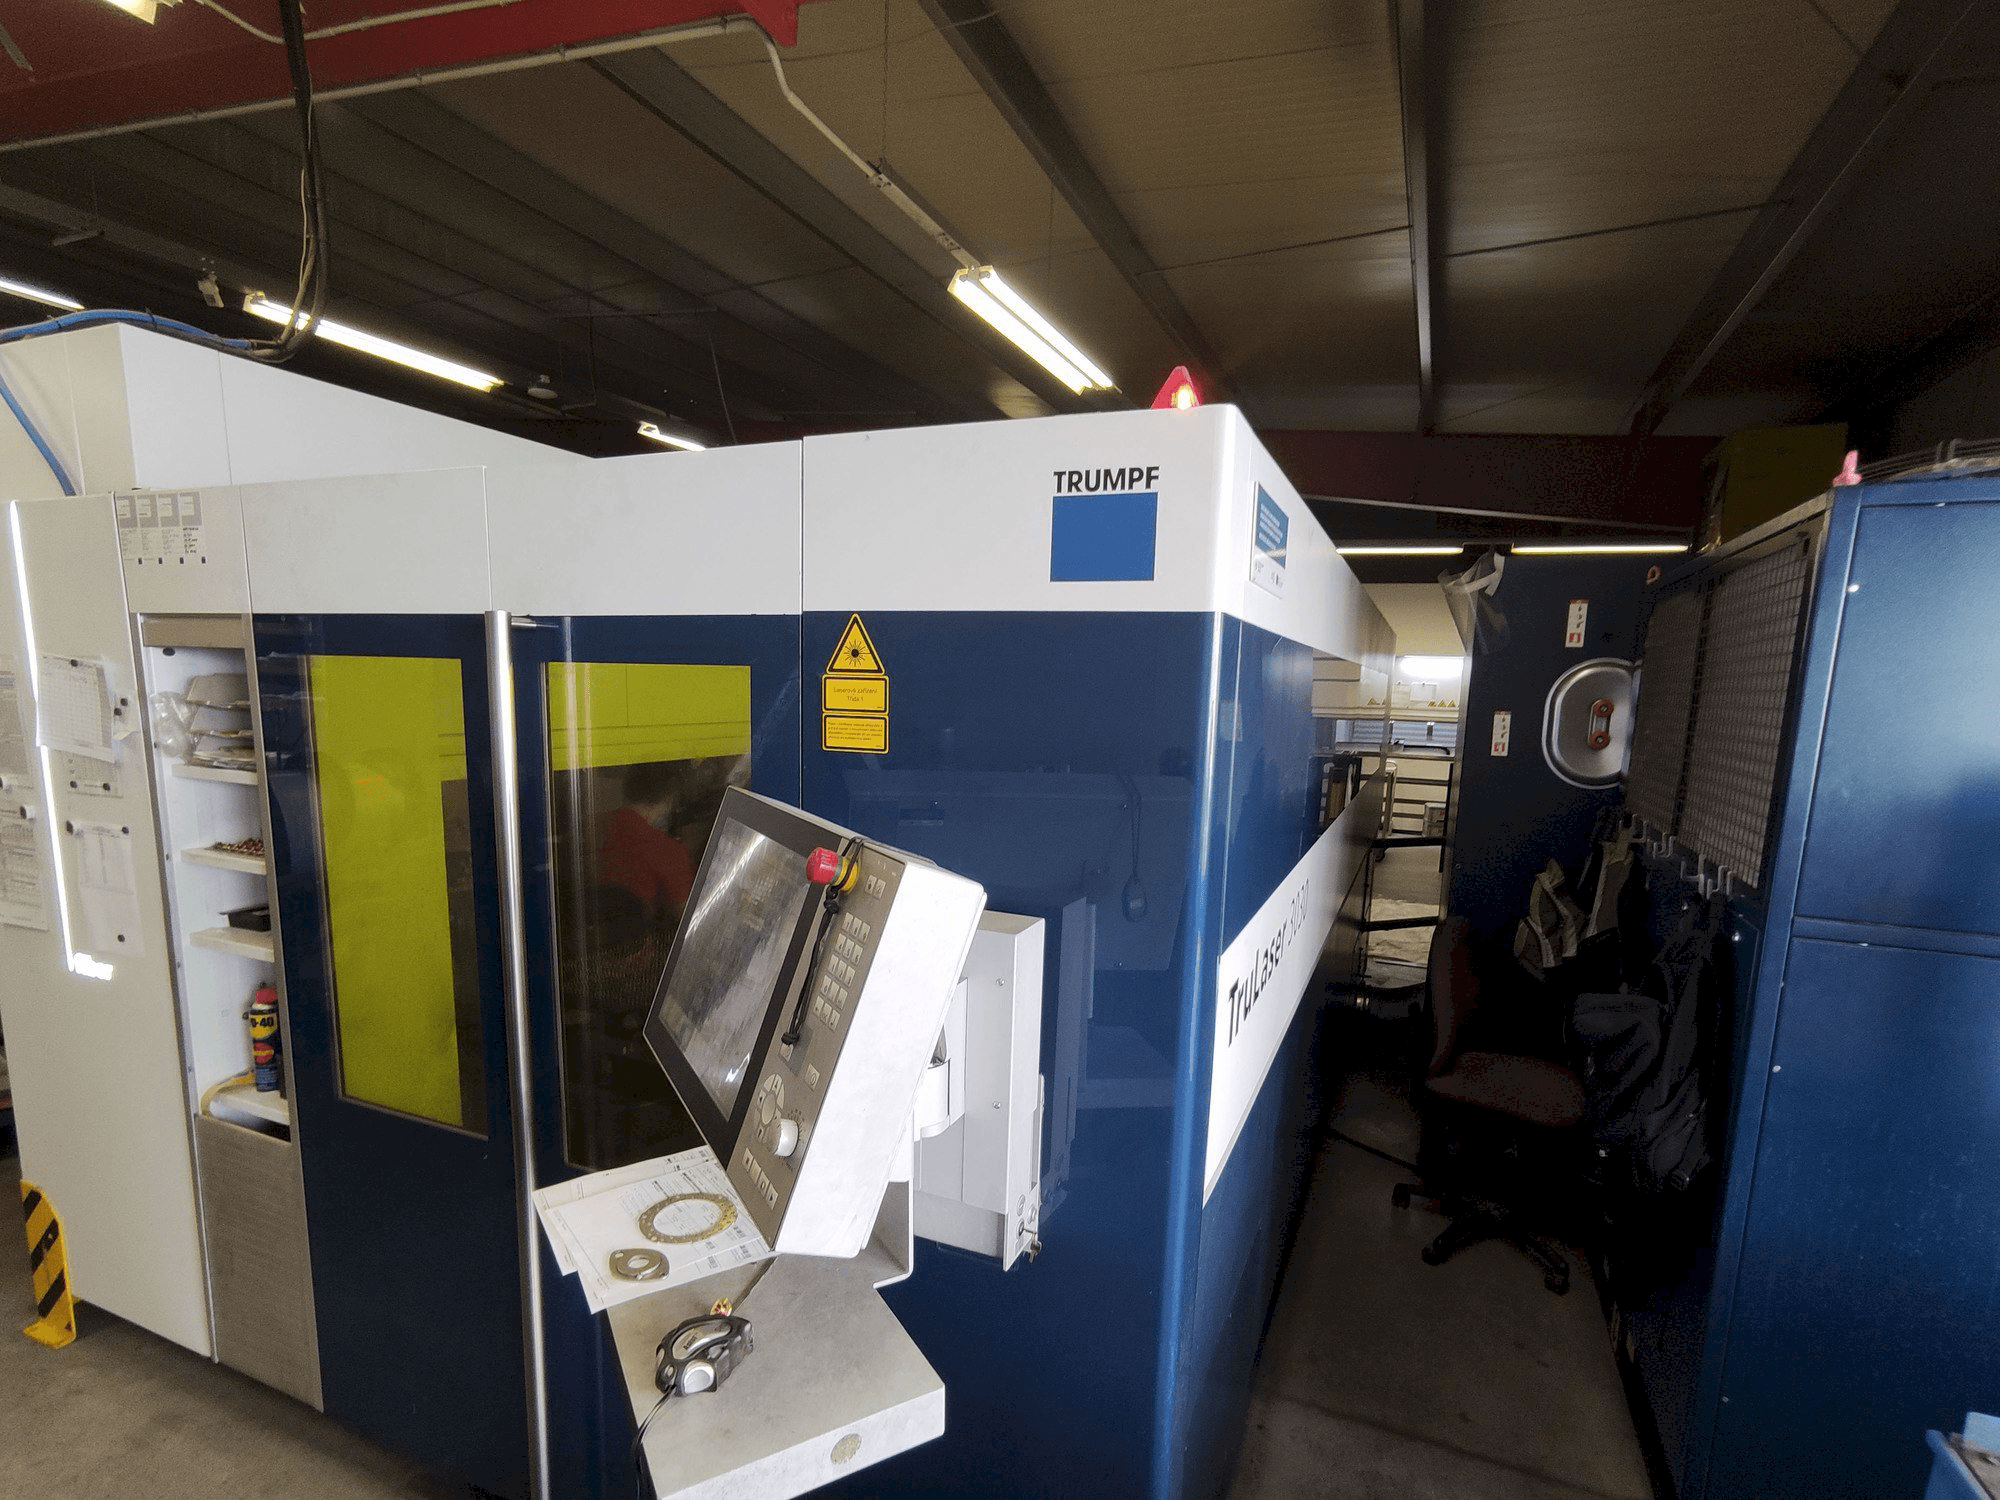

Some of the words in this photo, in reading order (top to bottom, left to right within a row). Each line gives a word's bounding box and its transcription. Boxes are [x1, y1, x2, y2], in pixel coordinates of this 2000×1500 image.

[1053, 466, 1159, 493] TRUMPF
[1228, 918, 1288, 1048] TruLaser
[1288, 878, 1309, 946] 3030
